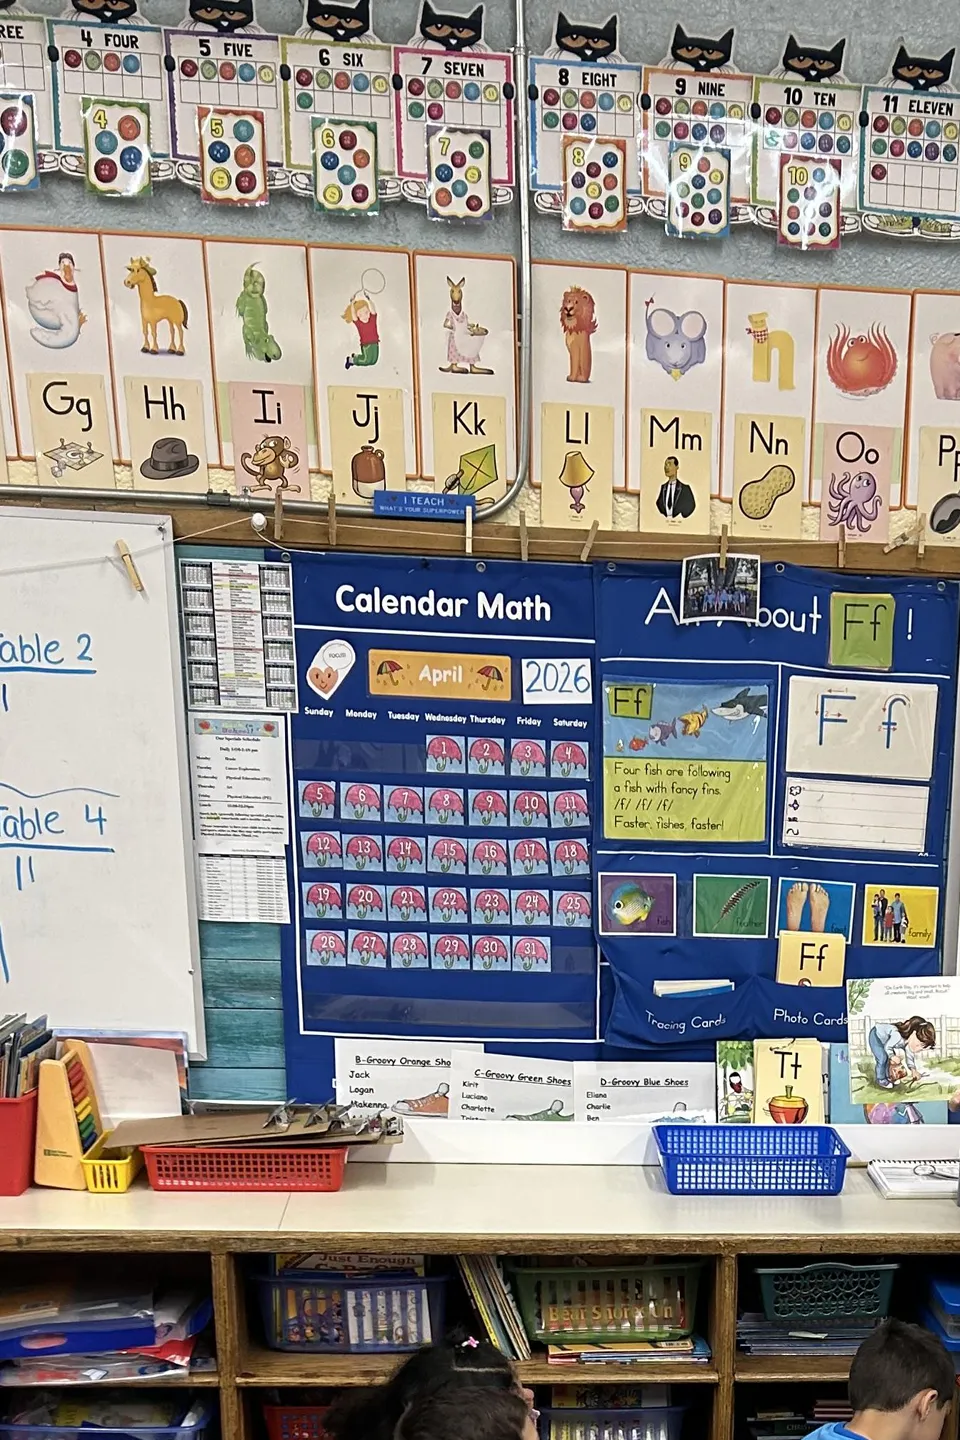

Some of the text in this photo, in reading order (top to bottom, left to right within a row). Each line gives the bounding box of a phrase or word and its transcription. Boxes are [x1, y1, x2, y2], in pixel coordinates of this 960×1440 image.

[81, 30, 138, 49] 4 FOUR
[200, 40, 253, 58] 5 FIVE
[318, 48, 364, 67] 6 SIX
[420, 58, 485, 77] 7 SEVEN
[558, 68, 617, 88] 8 EIGHT
[675, 79, 725, 96] 9 NINE
[784, 87, 836, 107] 10 TEN
[882, 95, 953, 116] 11 ELEVEN
[43, 382, 92, 431] Gg
[144, 385, 186, 421] Hh
[253, 389, 282, 425] Ii
[353, 394, 379, 443] Jj
[453, 401, 486, 436] Kk
[649, 417, 702, 452] Mm
[750, 420, 789, 455] Nn
[836, 432, 880, 465] Oo
[411, 497, 444, 506] TEACH
[336, 584, 550, 621] Calendar Math
[844, 603, 887, 641] Ff
[0, 632, 93, 664] able 2
[419, 664, 463, 687] April
[526, 660, 590, 693] 2026
[614, 687, 646, 715] Ff
[304, 706, 588, 728] Sunday Monday Tuesday Wednesday Thursday Friday Saturday
[615, 762, 731, 783] Four fish are following
[625, 780, 641, 793] fish
[646, 781, 667, 793] with
[671, 782, 698, 799] fancy
[702, 783, 721, 795] fins.
[614, 798, 673, 811] /f/ /f/ /f/
[0, 805, 107, 839] able 4
[691, 817, 724, 830] faster!
[908, 928, 932, 940] family
[800, 943, 828, 971] Ff
[646, 1010, 726, 1034] Tracing Cards
[774, 1009, 848, 1026] Photo Cards
[356, 1056, 430, 1067] B-Groovy Orange
[774, 1052, 802, 1079] Tt
[475, 1069, 571, 1085] C-Groovy Green Shoes
[601, 1078, 640, 1087] D-Groovy
[319, 1254, 416, 1265] Just Enough
